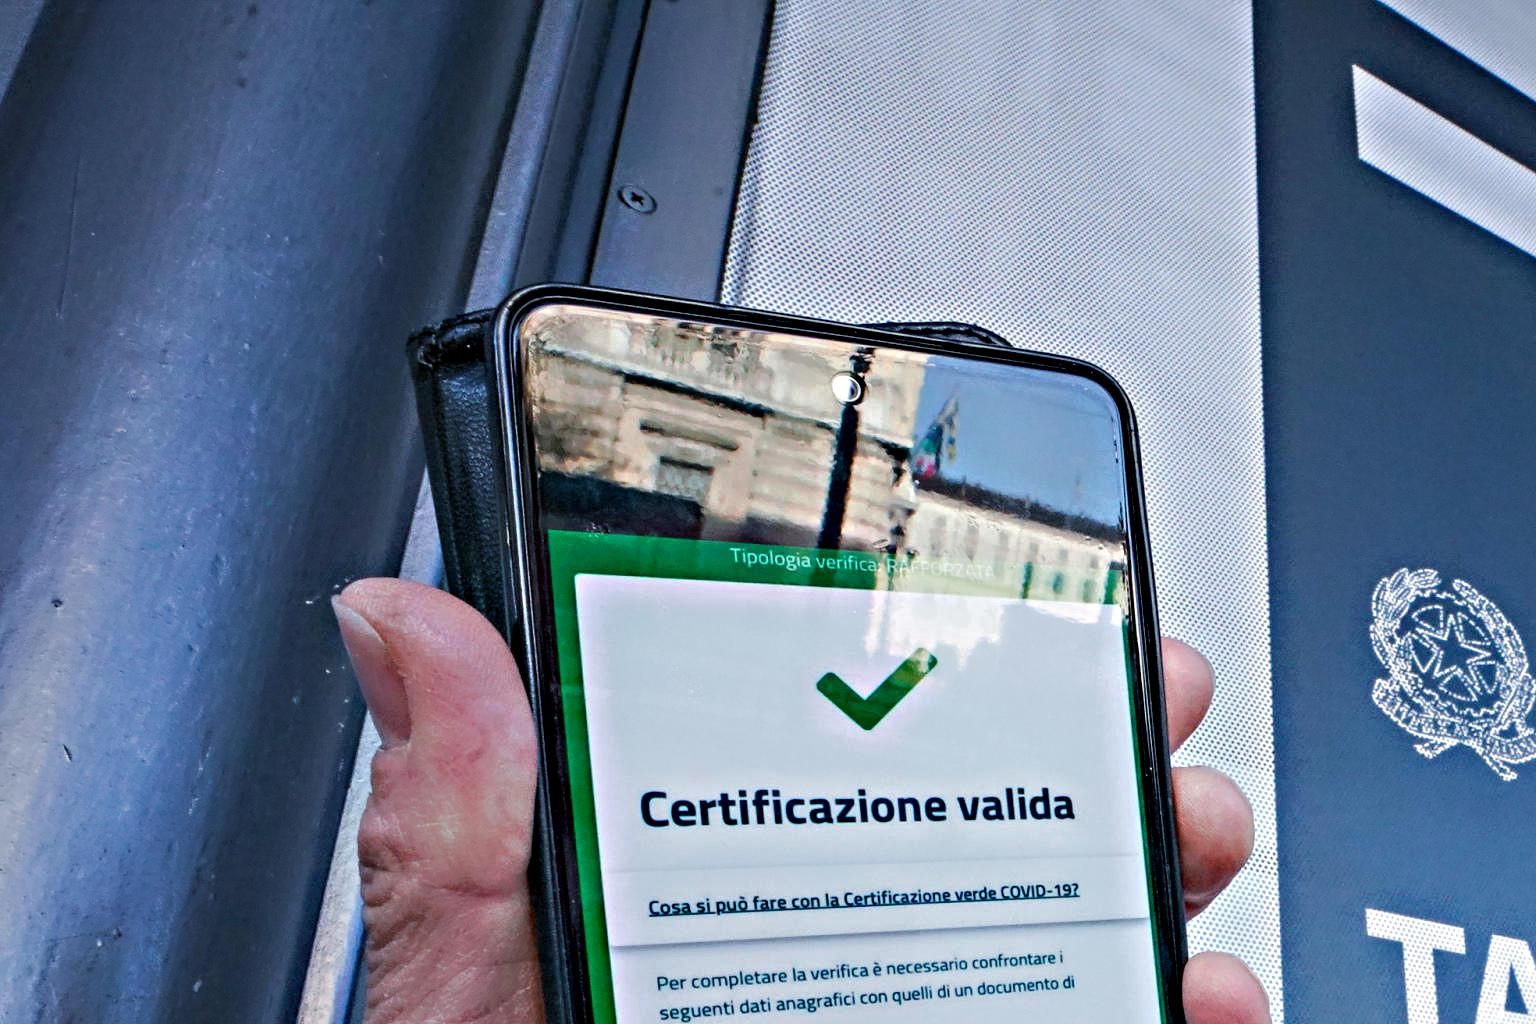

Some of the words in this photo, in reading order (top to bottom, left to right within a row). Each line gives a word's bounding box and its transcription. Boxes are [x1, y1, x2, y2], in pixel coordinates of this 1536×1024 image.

[730, 547, 811, 572] Tipologia
[640, 789, 948, 828] Certificazione
[957, 787, 1076, 821] valida
[649, 899, 693, 916] Cosa
[696, 898, 712, 914] si
[716, 896, 748, 916] può
[753, 894, 787, 912] fare
[791, 896, 820, 910] con
[825, 891, 840, 908] la
[844, 887, 951, 908] Certificazione
[955, 885, 997, 902] verde
[1000, 883, 1080, 900] COVID-19?
[656, 975, 687, 992] Per
[691, 969, 788, 993] completare
[792, 966, 807, 982] la
[810, 961, 870, 980] verifica
[873, 960, 882, 976] è
[886, 957, 968, 976] necessario
[972, 952, 1056, 970] confrontare
[659, 1000, 735, 1023] seguenti
[739, 996, 771, 1014] dati
[776, 992, 856, 1014] anagrafici
[860, 990, 888, 1005] con
[892, 985, 933, 1006] quelli
[937, 984, 951, 998] di
[954, 984, 974, 998] un
[977, 977, 1059, 996] documento
[1062, 975, 1076, 990] di
